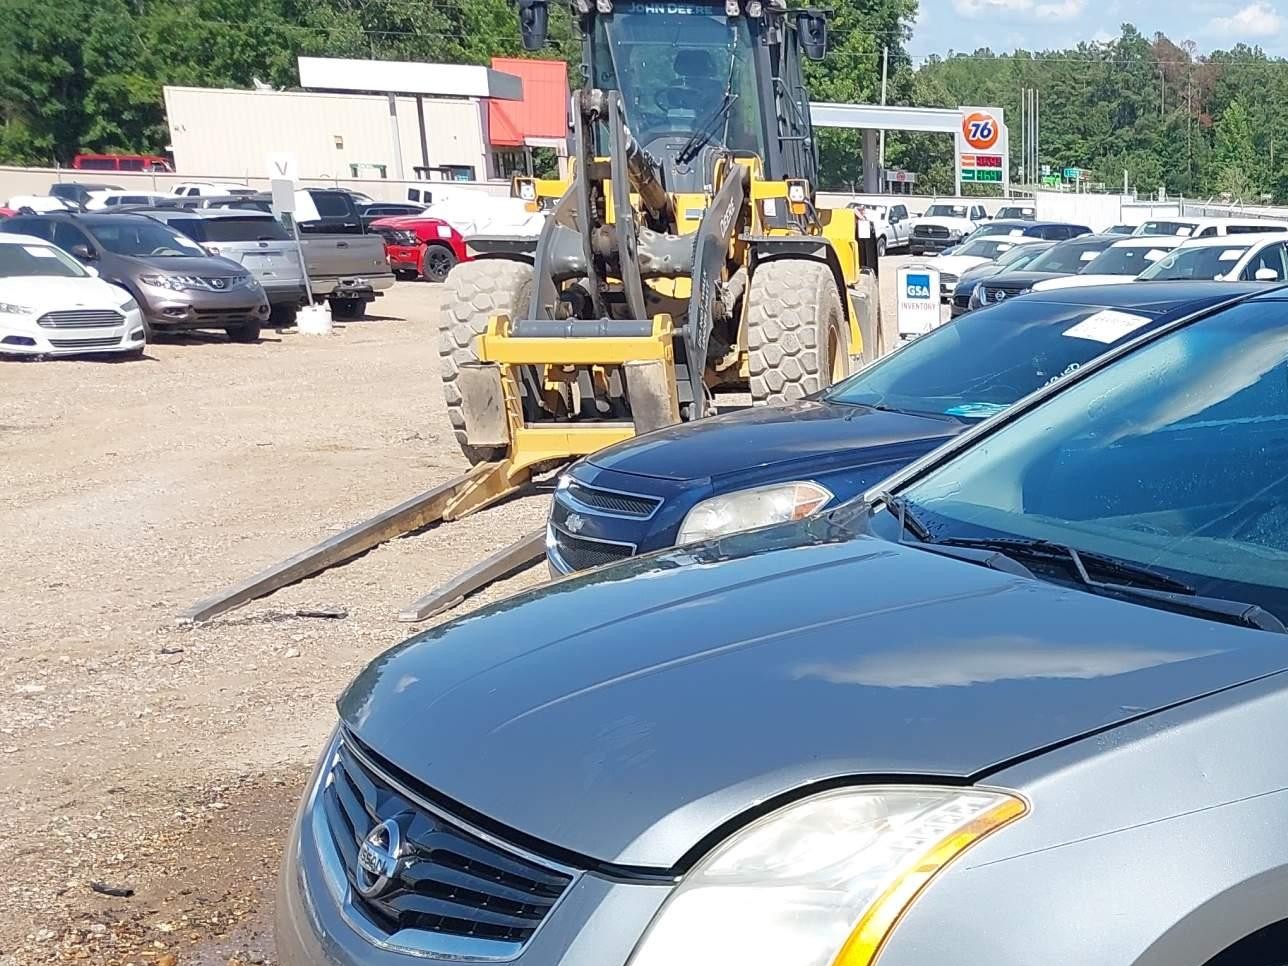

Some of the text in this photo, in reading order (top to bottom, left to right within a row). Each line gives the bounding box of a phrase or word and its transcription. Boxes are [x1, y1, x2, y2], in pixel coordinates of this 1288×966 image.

[628, 3, 713, 15] JOHN DEERE
[971, 121, 992, 139] 76
[274, 160, 288, 176] V
[907, 285, 930, 297] GSA
[901, 302, 936, 311] INVENTORY
